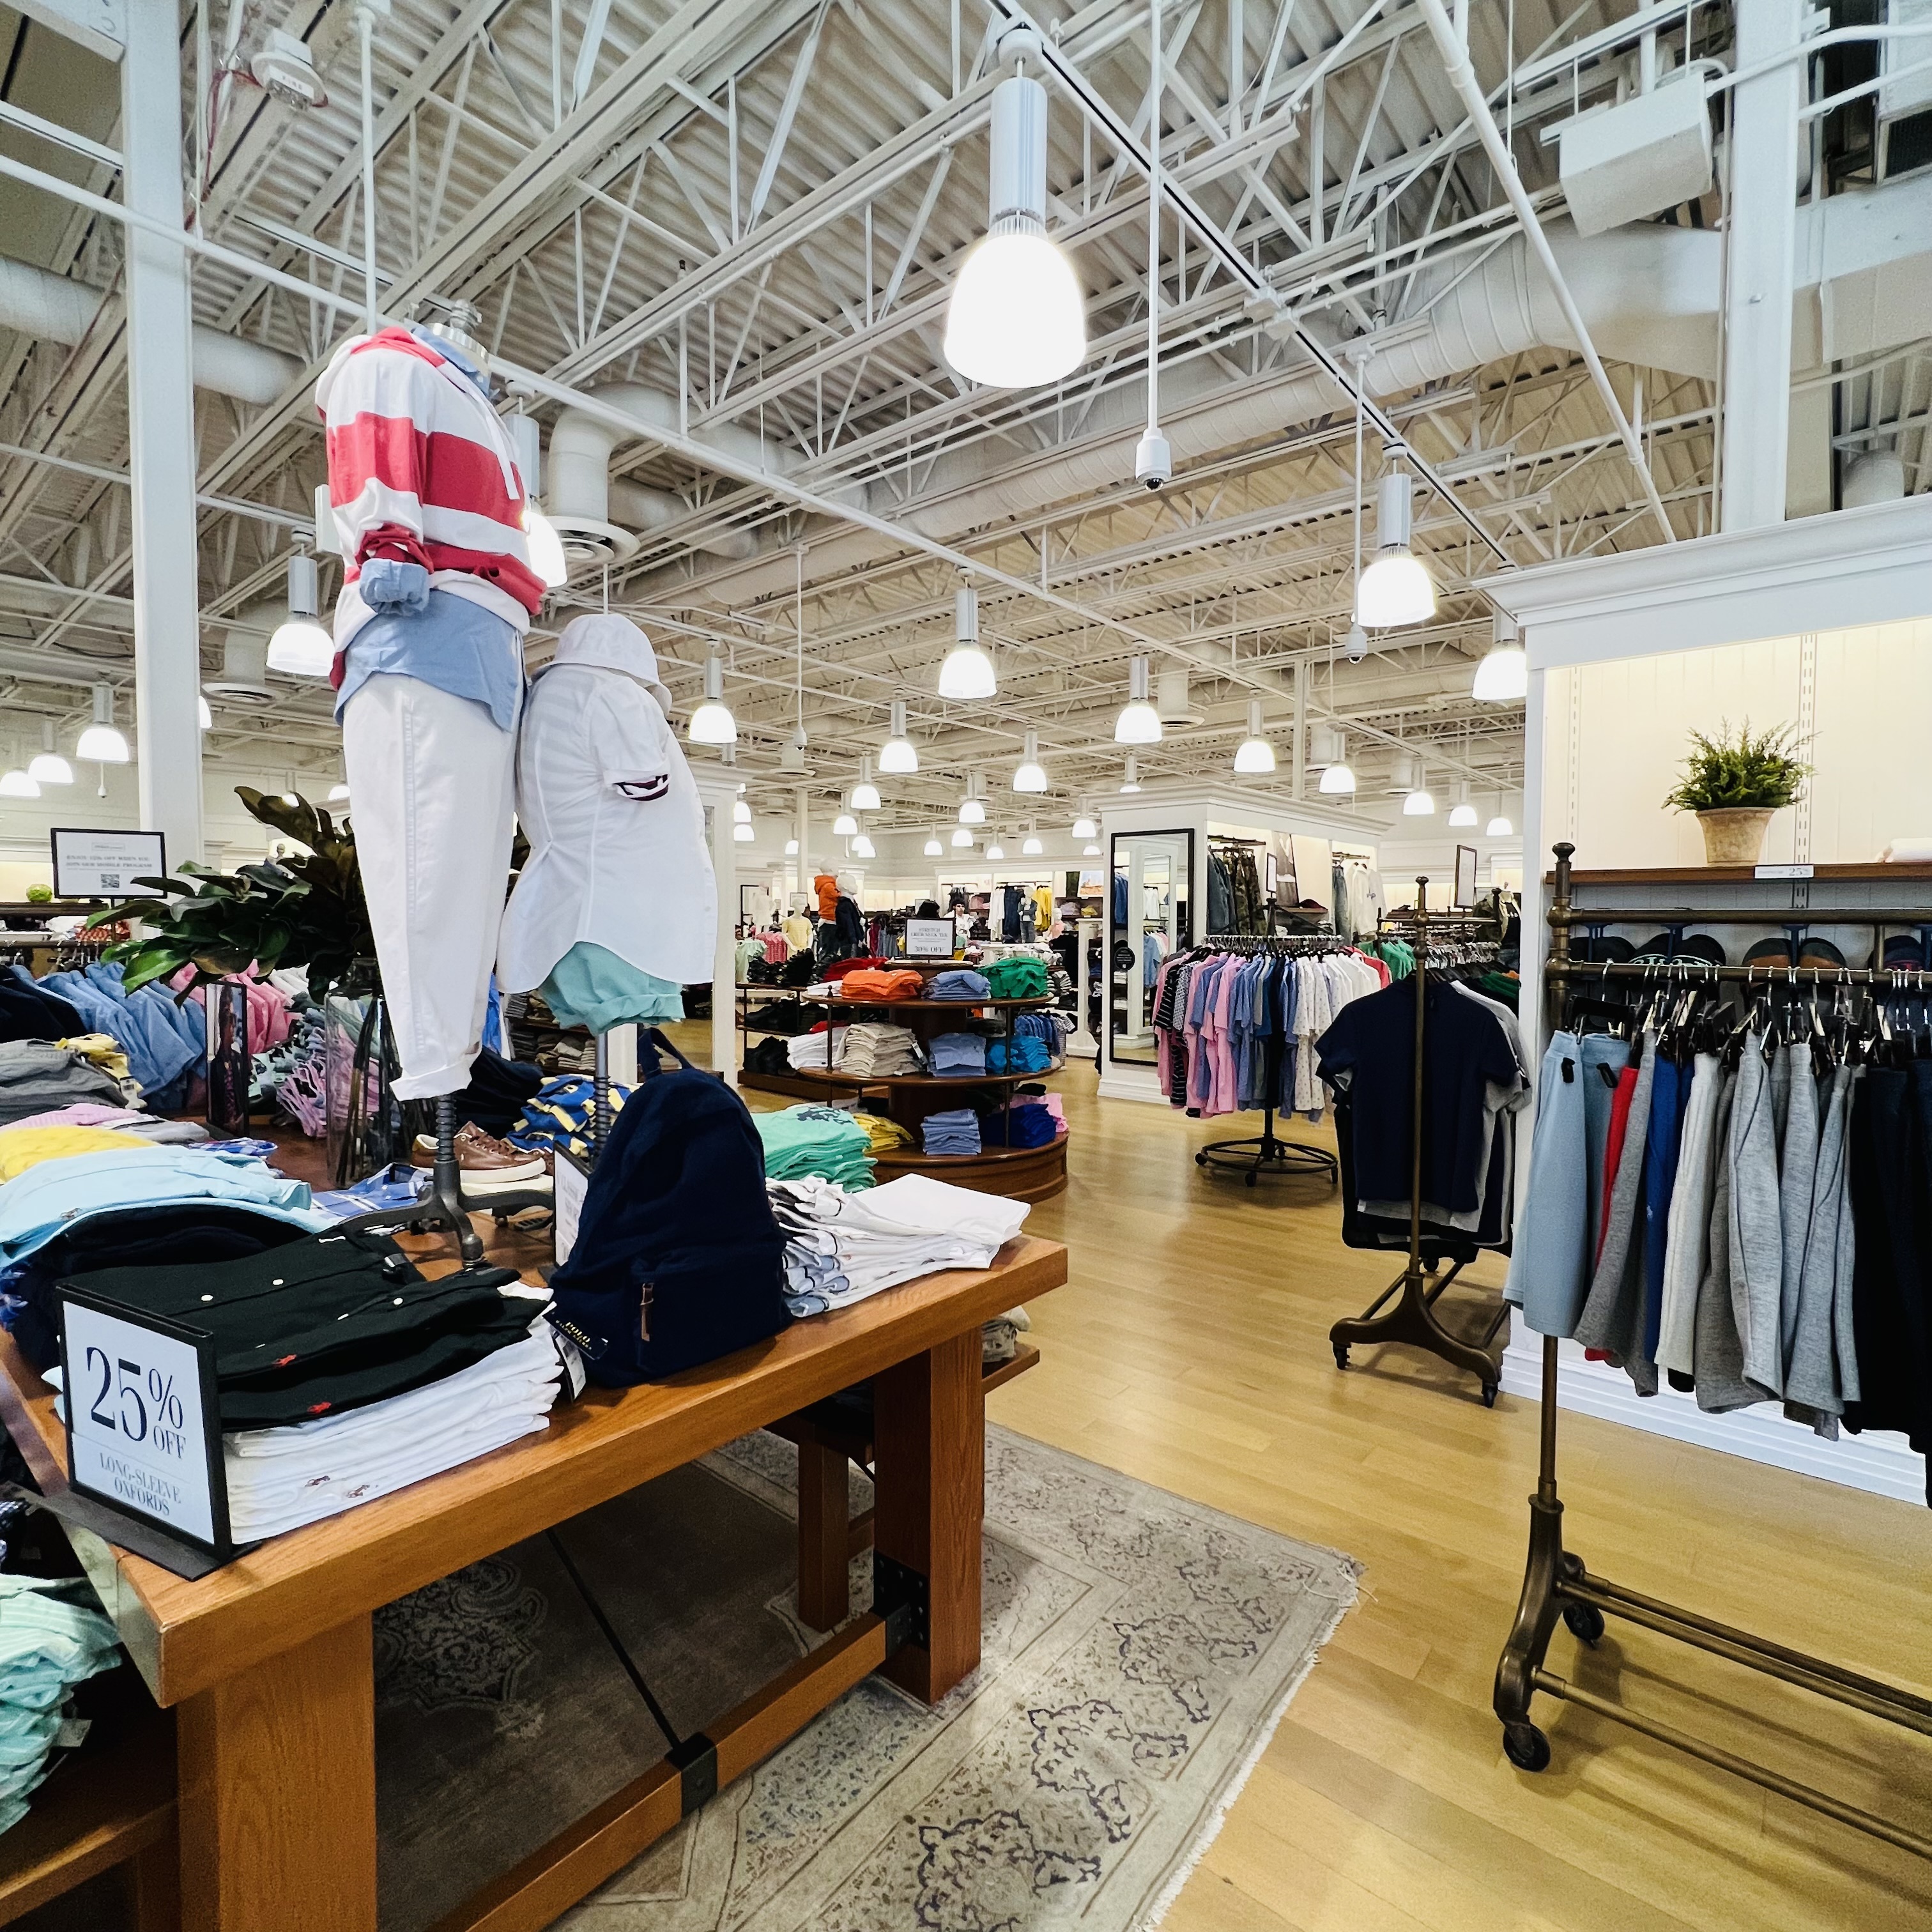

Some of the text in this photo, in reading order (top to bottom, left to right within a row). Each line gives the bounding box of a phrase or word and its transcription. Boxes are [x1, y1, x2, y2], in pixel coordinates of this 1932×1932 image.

[565, 1321, 591, 1343] POLO
[86, 1347, 183, 1442] 25%
[153, 1425, 187, 1460] OFF
[100, 1453, 181, 1505] LONG-SLEEVE
[114, 1478, 170, 1516] OXFORDS
